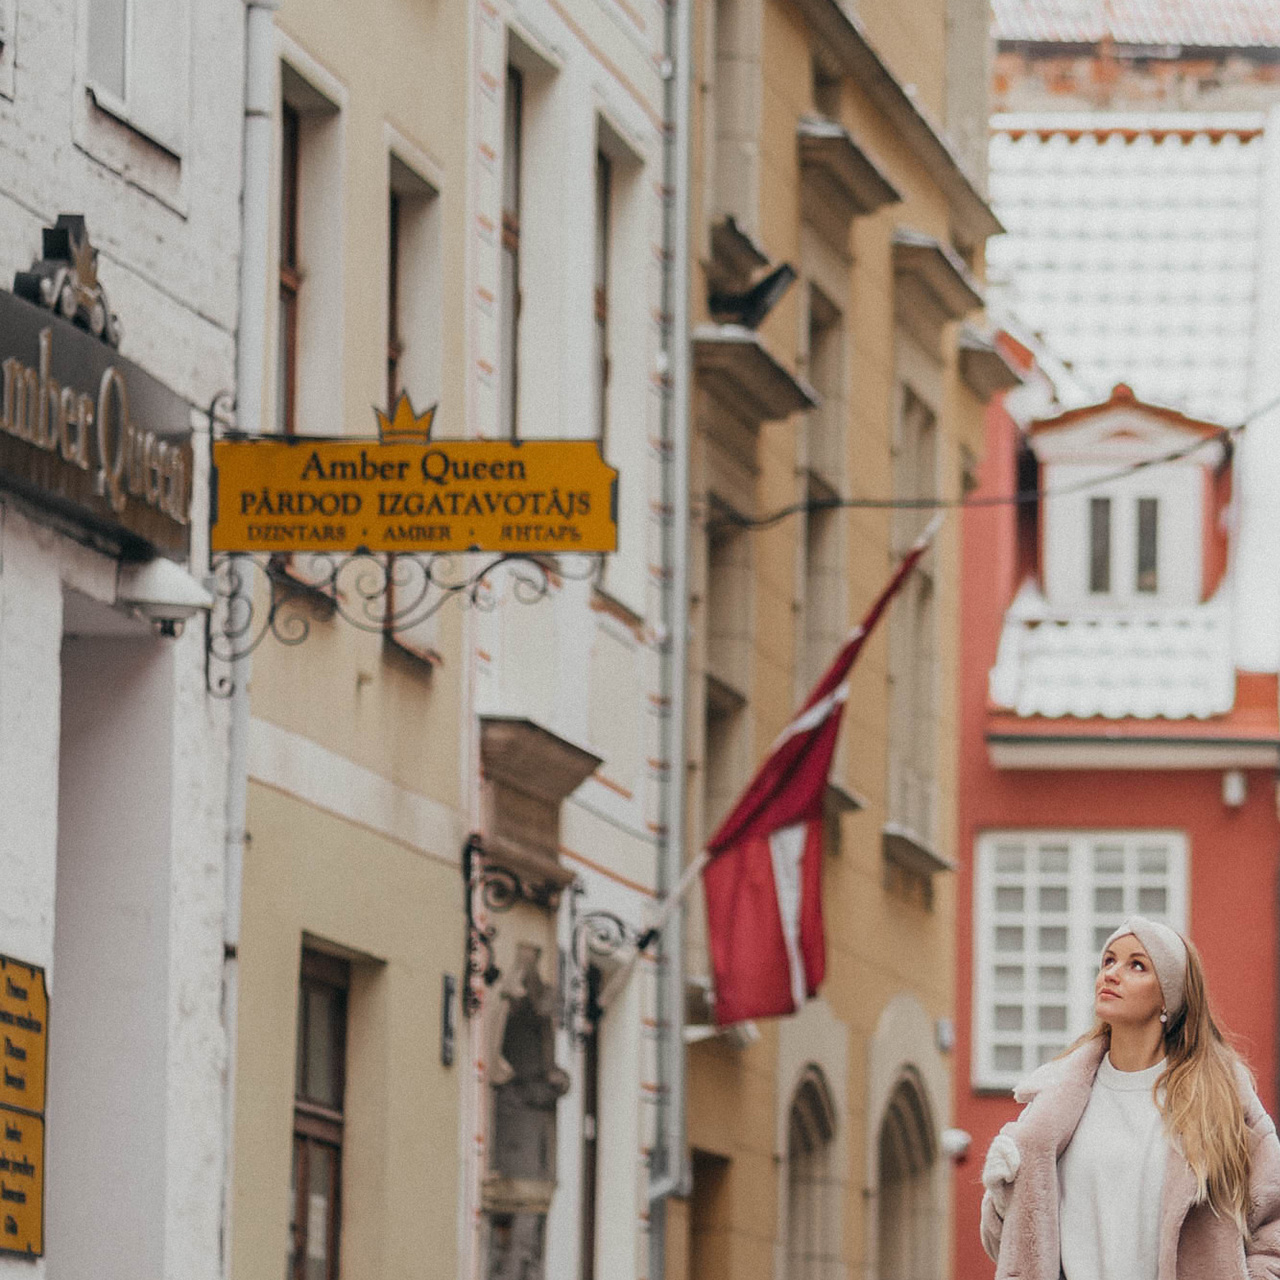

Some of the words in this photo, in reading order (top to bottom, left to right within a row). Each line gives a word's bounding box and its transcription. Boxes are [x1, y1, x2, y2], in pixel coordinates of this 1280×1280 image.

[96, 365, 193, 526] Queen
[301, 450, 411, 481] Amber
[421, 450, 527, 486] Queen
[247, 524, 347, 542] DZINTARS
[383, 524, 452, 542] AMBER
